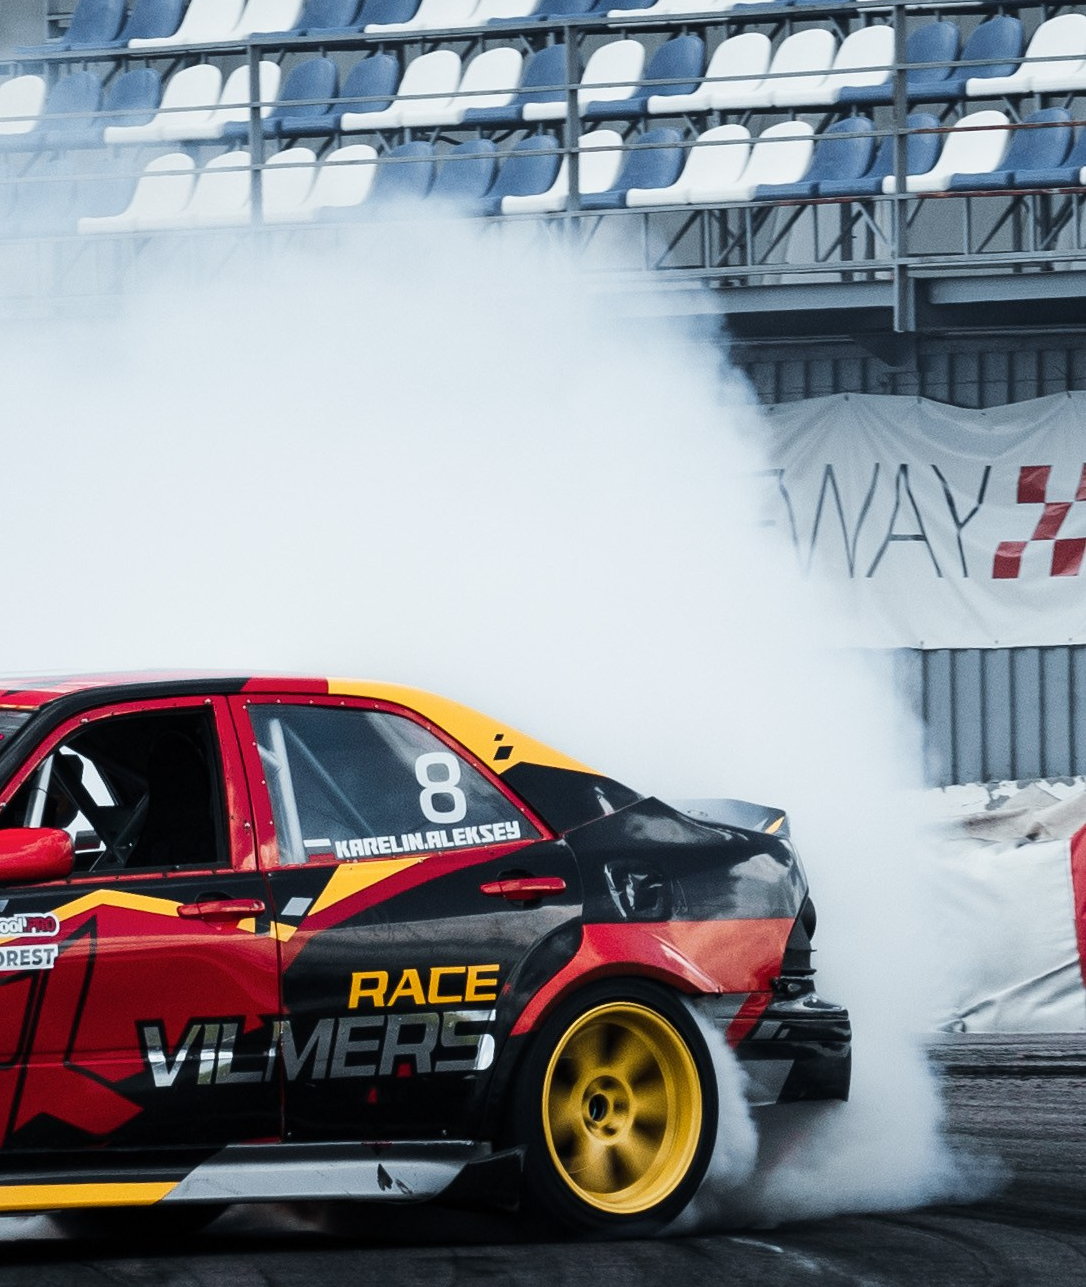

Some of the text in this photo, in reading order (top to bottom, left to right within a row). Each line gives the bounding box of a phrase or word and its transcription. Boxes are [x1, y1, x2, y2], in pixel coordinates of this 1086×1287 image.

[414, 751, 468, 824] 8
[334, 820, 522, 859] KARELIN.ALEKSEY
[347, 963, 500, 1009] RACE
[142, 1008, 498, 1088] VILMERS
